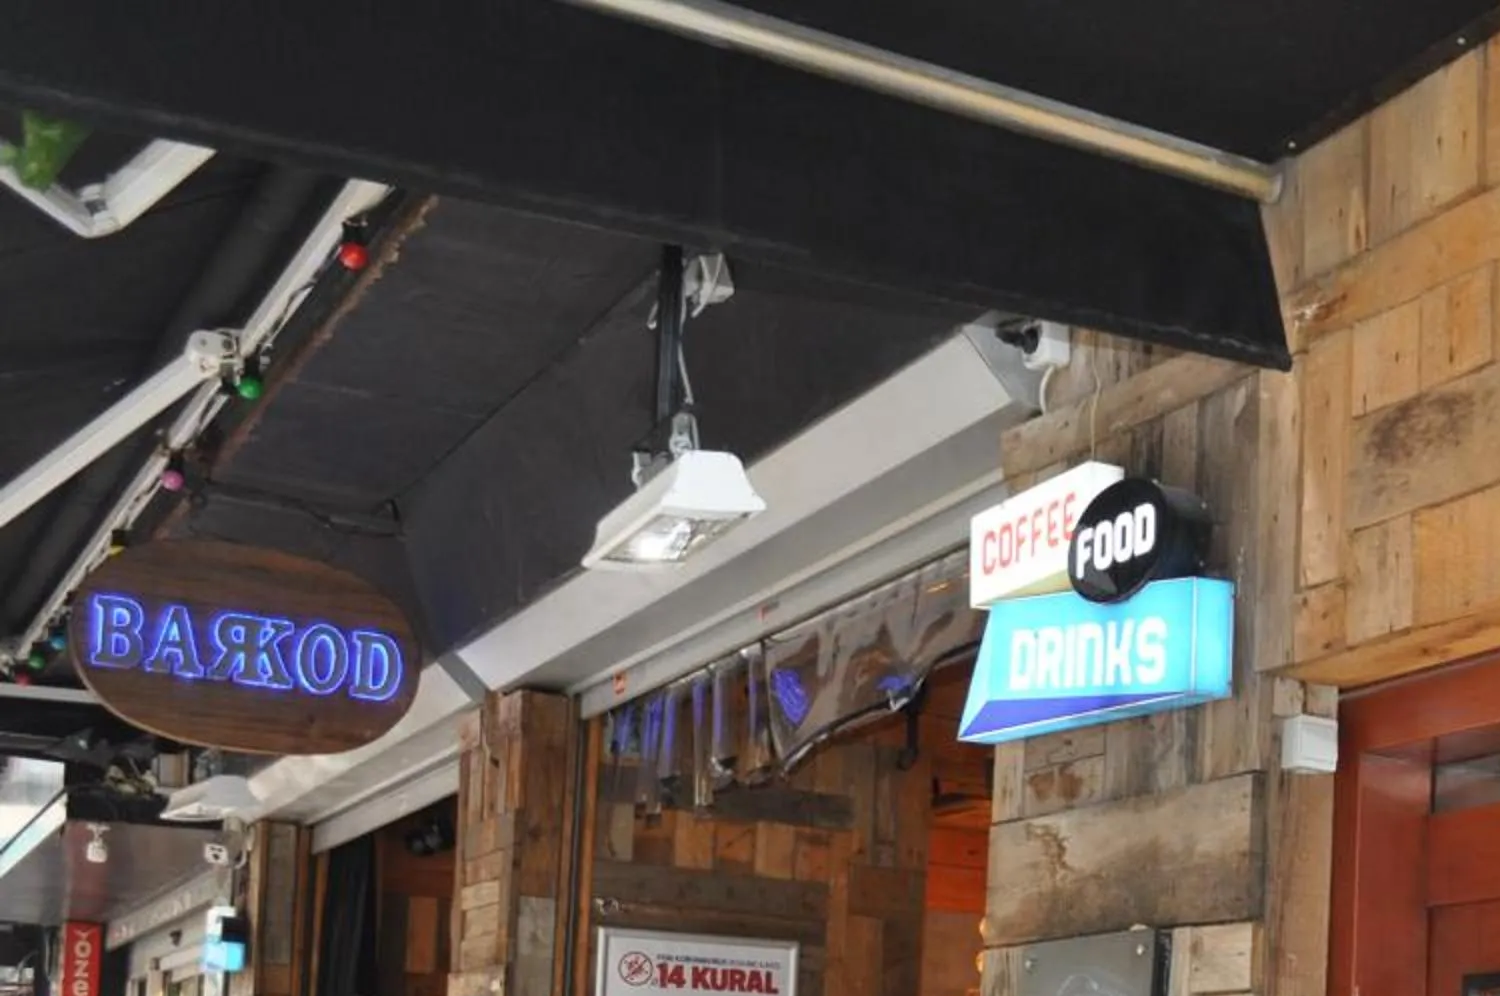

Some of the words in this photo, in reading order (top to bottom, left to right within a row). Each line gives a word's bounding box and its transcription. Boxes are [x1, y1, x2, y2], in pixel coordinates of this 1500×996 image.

[981, 492, 1076, 576] COFFEE
[1075, 503, 1157, 580] FOOD
[91, 593, 403, 701] BARKOD
[1008, 616, 1168, 691] DRINKS
[656, 962, 686, 989] 14
[691, 965, 779, 995] KURAL
